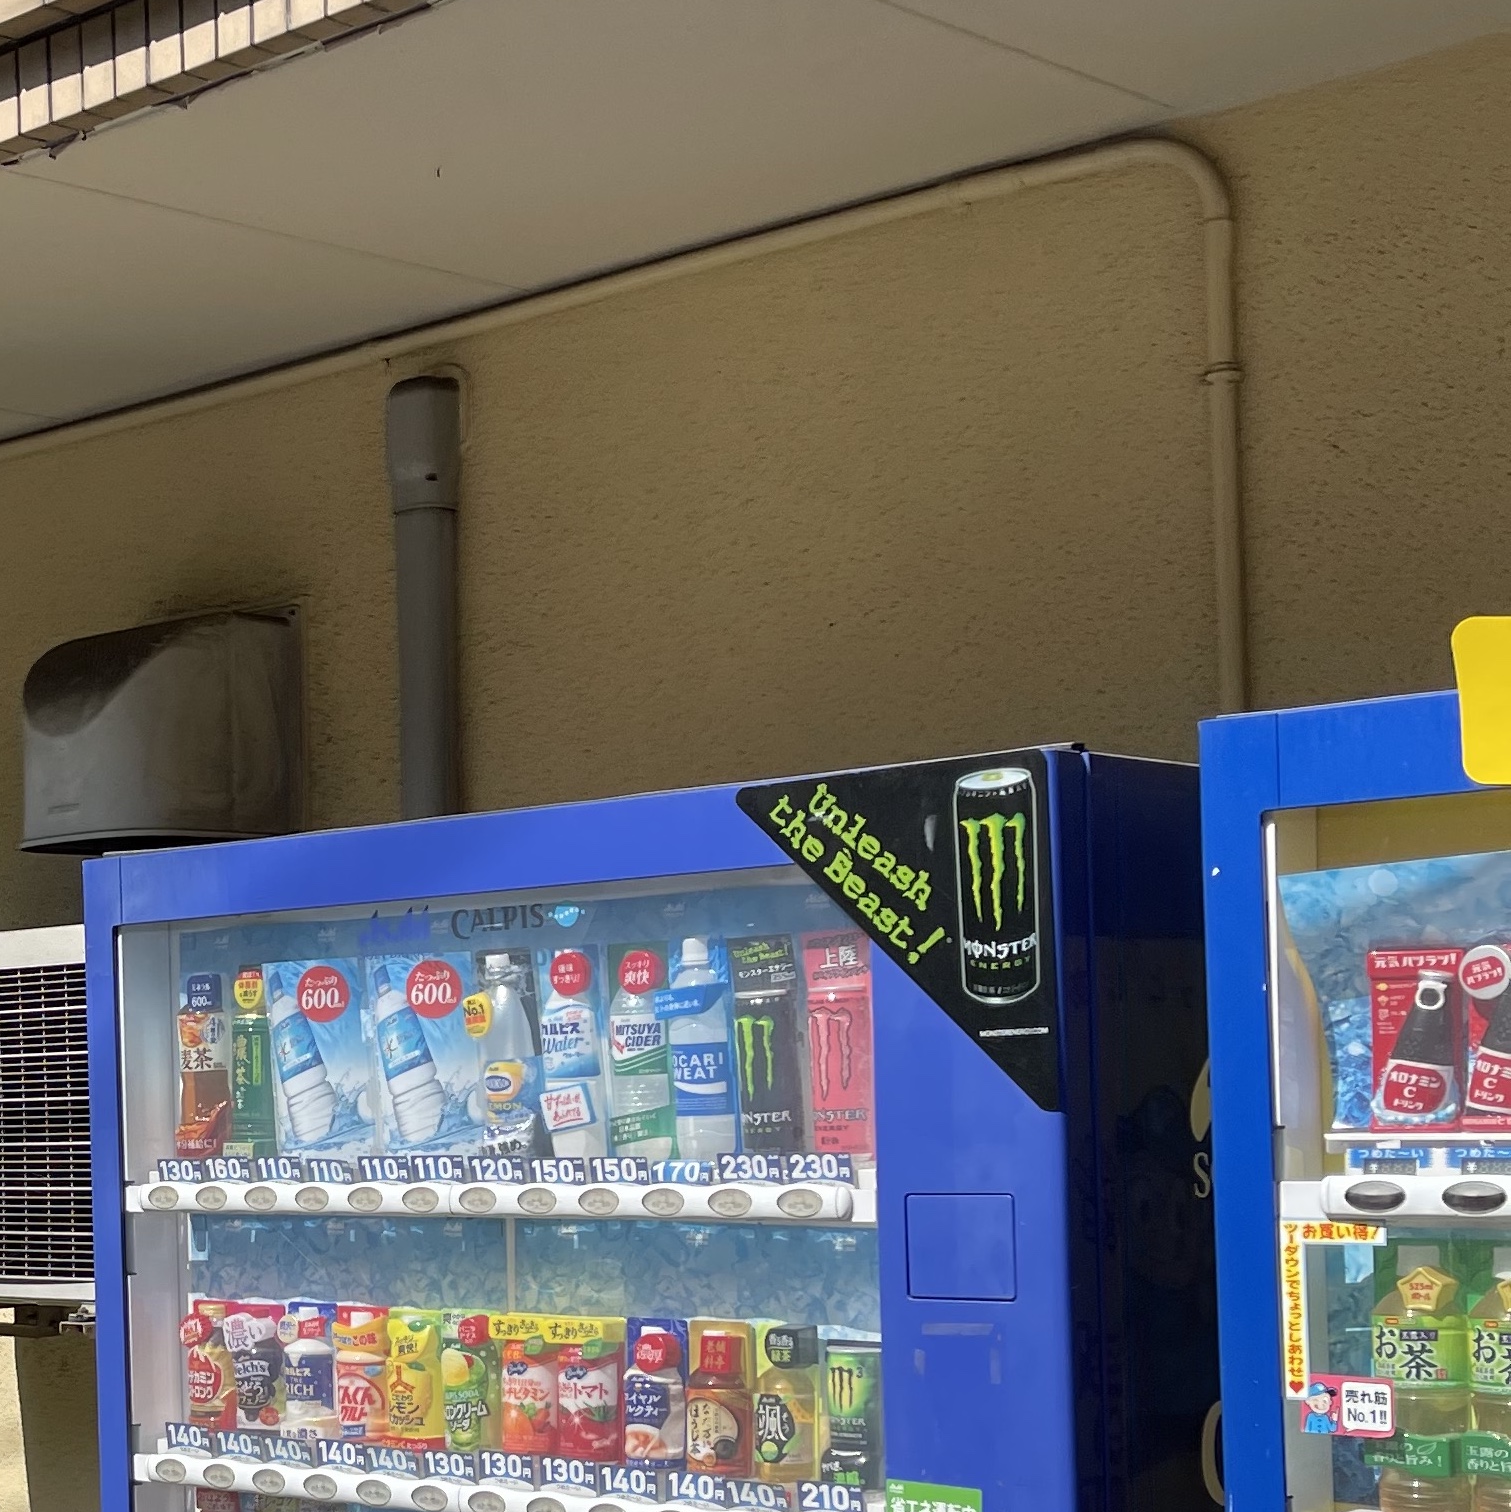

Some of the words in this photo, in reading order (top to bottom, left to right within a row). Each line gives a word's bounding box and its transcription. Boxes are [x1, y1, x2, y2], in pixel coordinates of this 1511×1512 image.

[808, 783, 934, 912] Unleash
[769, 795, 825, 863] the
[824, 846, 945, 965] Beast!
[451, 904, 544, 939] CALPIS
[820, 944, 859, 968] 上陸
[1374, 953, 1456, 969] 元気ハツラツ!
[414, 971, 450, 983] たっぷり
[624, 970, 650, 986] 爽快
[1466, 968, 1503, 986] ハツラツ!
[1471, 963, 1492, 972] 元気
[304, 977, 338, 989] たっぷり
[615, 1022, 661, 1036] MITSUYA
[543, 1037, 584, 1054] Water
[625, 1035, 661, 1047] CIDER
[672, 1052, 723, 1067] OCARI
[674, 1066, 717, 1081] WEAT
[1388, 1070, 1441, 1089] オロナミン
[1483, 1077, 1498, 1089] C
[1404, 1086, 1416, 1098] C
[1474, 1090, 1505, 1103] ドリンク
[1394, 1098, 1424, 1111] ドリンク
[1455, 1148, 1511, 1158] つめた～
[159, 1159, 202, 1181] 130円
[206, 1159, 250, 1180] 160円
[259, 1158, 300, 1180] 110円
[310, 1161, 353, 1183] 110円
[361, 1158, 408, 1181] 110円
[415, 1156, 463, 1180] 110円
[471, 1157, 523, 1181] 120円
[531, 1159, 584, 1182] 150円
[592, 1158, 648, 1182] 150円
[653, 1162, 712, 1183] 170円
[720, 1155, 781, 1181] 230円
[790, 1155, 851, 1179] 230円
[1302, 1224, 1379, 1241] お買い得!
[1375, 1324, 1437, 1380] お茶
[573, 1382, 609, 1399] トマト
[1345, 1389, 1388, 1406] 売れ筋
[1347, 1408, 1387, 1424] No.1!!
[168, 1425, 210, 1447] 140円
[218, 1433, 260, 1454] 140円
[266, 1438, 310, 1460] 140円
[319, 1441, 364, 1465] 140円
[367, 1447, 417, 1472] 140円
[1466, 1445, 1510, 1459] 玉露の
[425, 1452, 474, 1477] 130円
[481, 1452, 531, 1479] 130円
[542, 1457, 594, 1484] 130円
[601, 1468, 656, 1494] 140円
[669, 1473, 725, 1500] 140円
[726, 1482, 787, 1507] 140円
[801, 1484, 862, 1512] 210円
